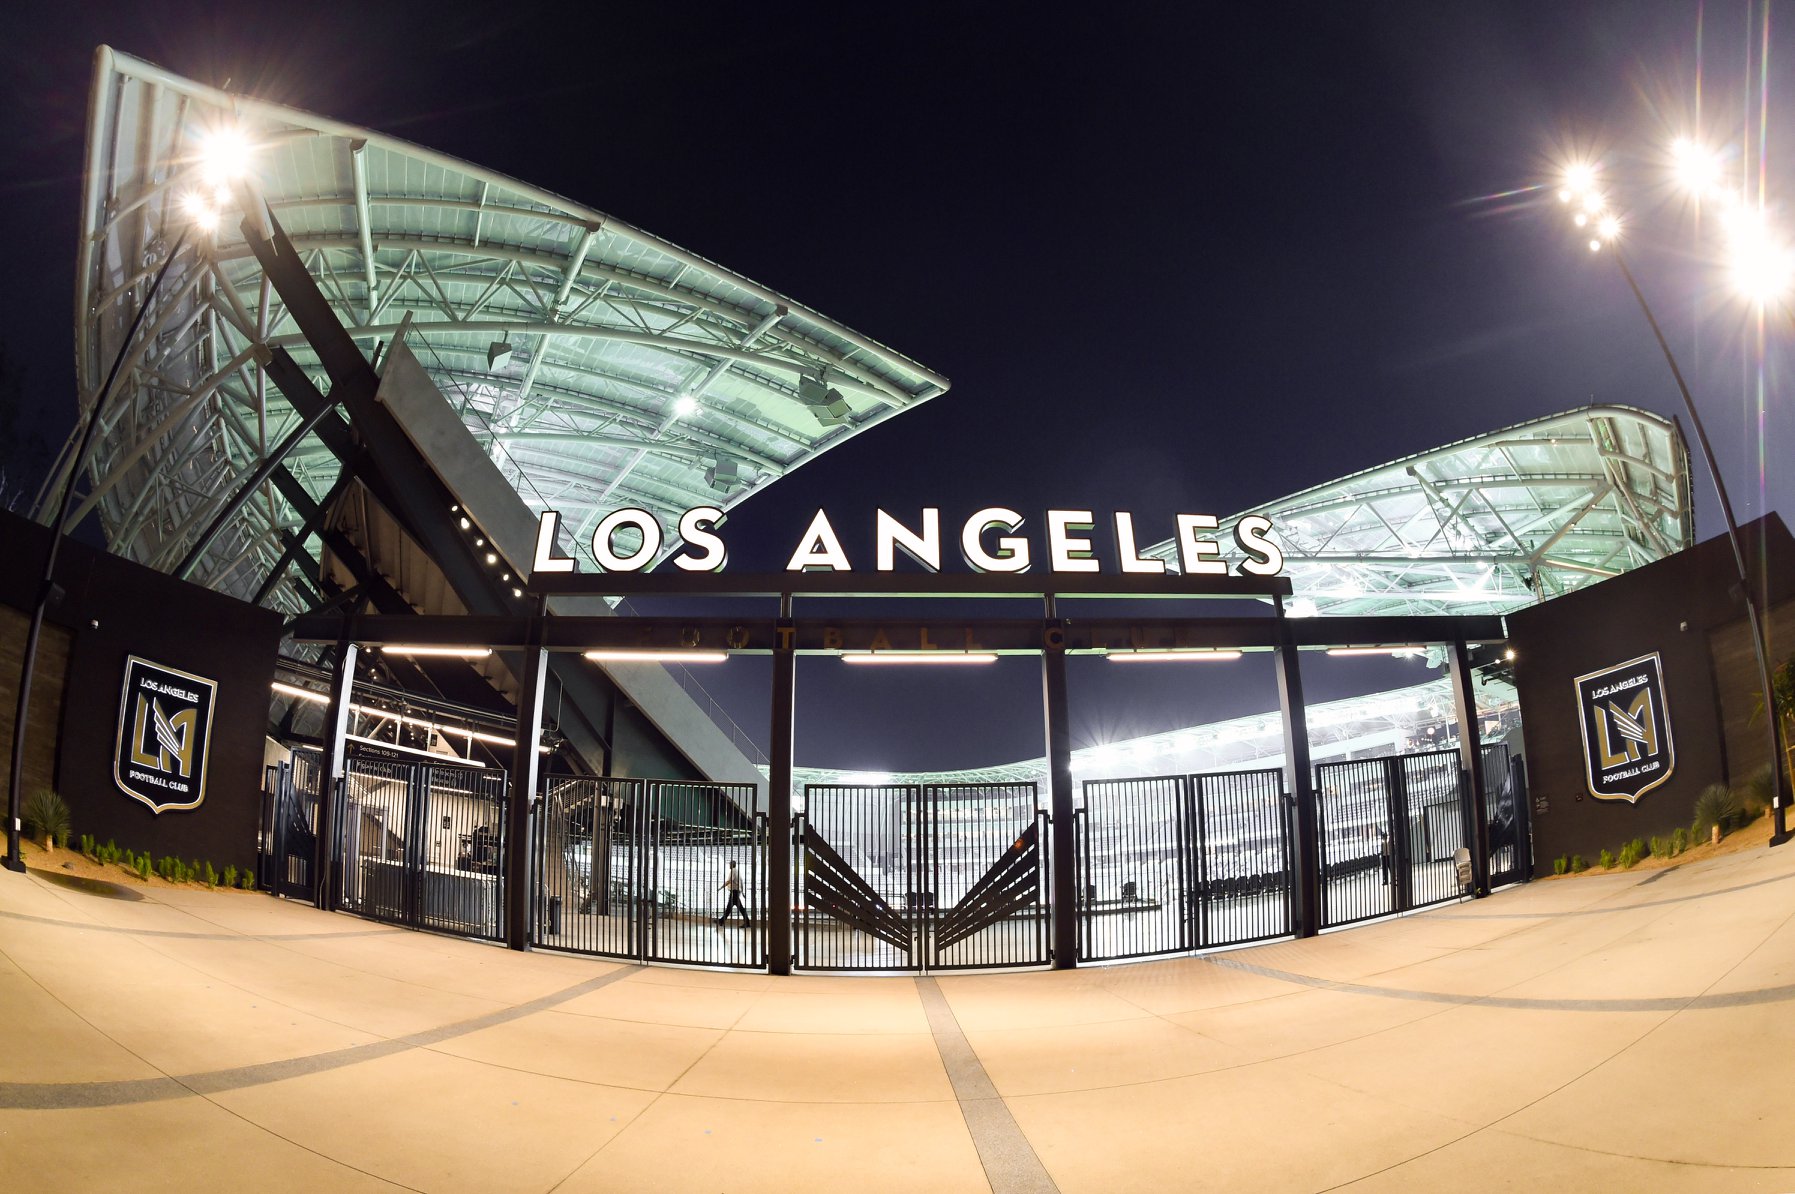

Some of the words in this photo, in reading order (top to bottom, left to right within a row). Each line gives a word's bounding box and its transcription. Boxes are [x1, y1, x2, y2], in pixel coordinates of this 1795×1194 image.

[532, 507, 728, 574] LOS
[785, 507, 1284, 577] ANGELES
[642, 625, 983, 649] OOTBALL
[140, 677, 158, 692] LOS
[159, 682, 199, 703] ANGELES
[1592, 685, 1608, 699] LOS
[1607, 674, 1649, 696] ANGELES
[359, 744, 380, 755] Sections
[129, 769, 168, 788] FOOTBALL
[169, 780, 189, 793] CLUB
[1602, 768, 1641, 784] FOOTBALL
[1641, 760, 1660, 774] CLUB
